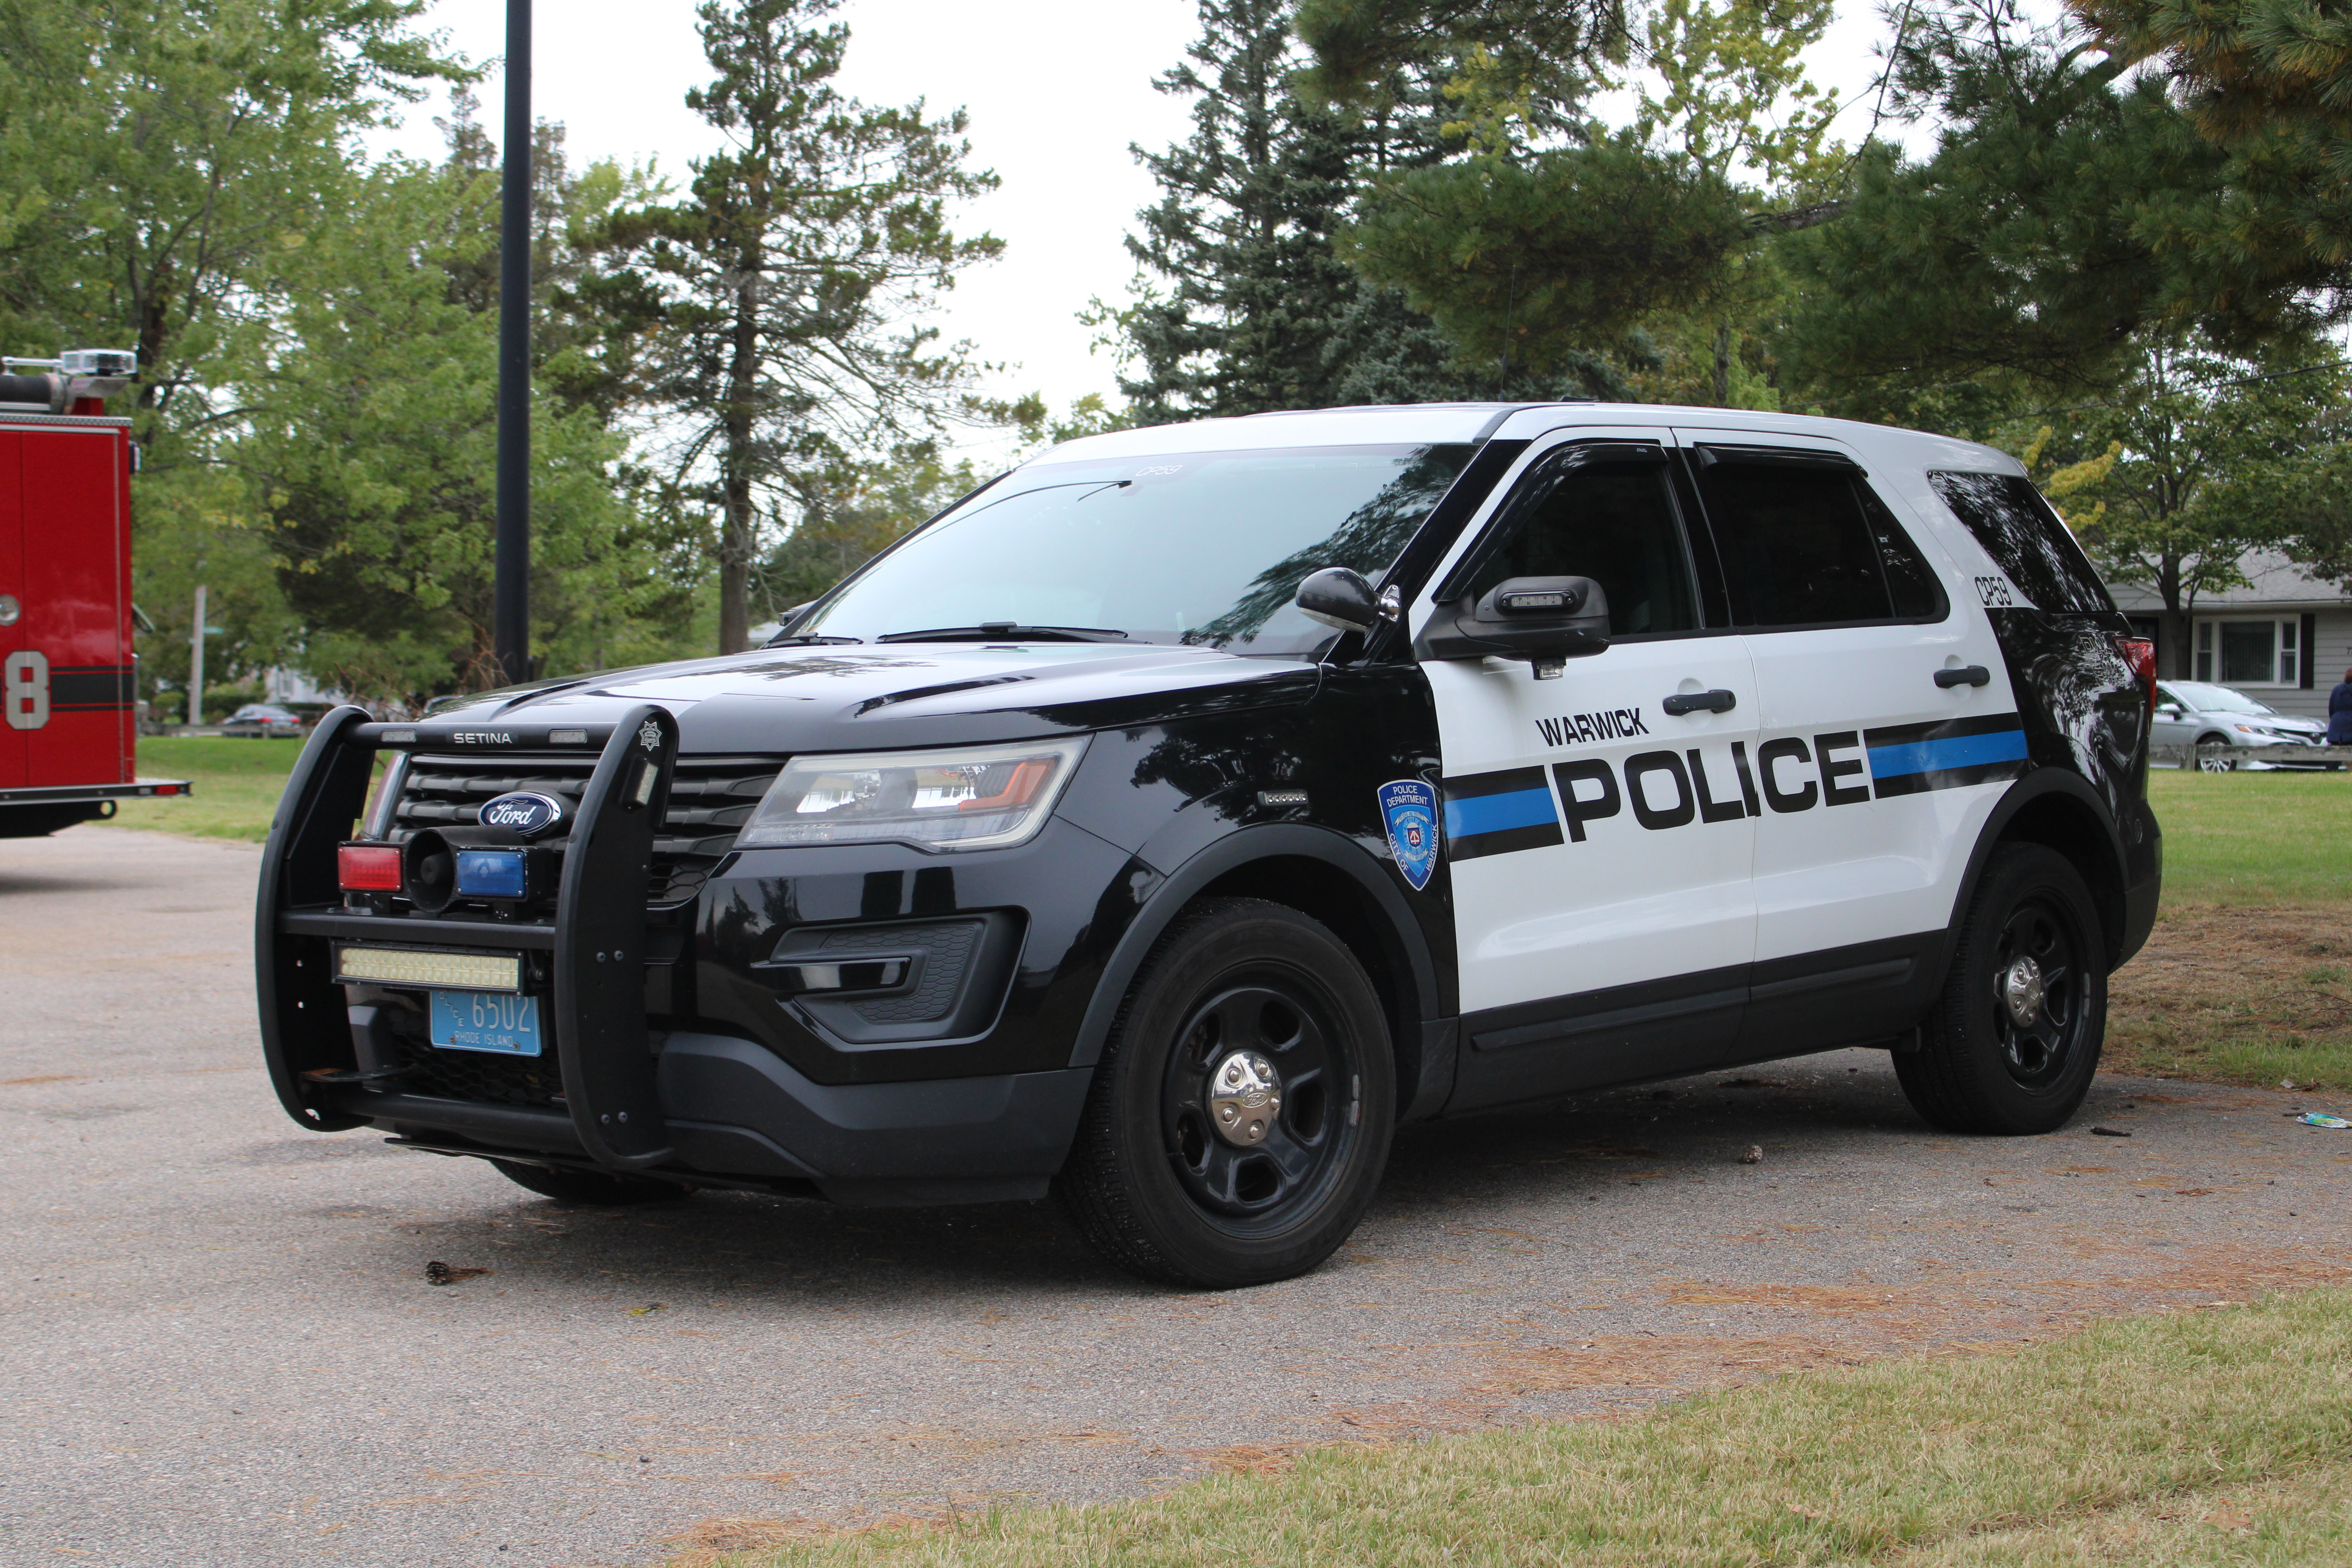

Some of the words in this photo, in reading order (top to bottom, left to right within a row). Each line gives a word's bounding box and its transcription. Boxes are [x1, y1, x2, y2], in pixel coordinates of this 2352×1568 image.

[1135, 465, 1183, 477] CP59
[1975, 577, 2012, 606] CP59
[4, 651, 49, 730] 8
[454, 733, 512, 744] SETINA
[1535, 708, 1649, 747] WARWICK
[1387, 794, 1428, 808] DEPARTMENT
[1393, 785, 1417, 795] POLICE
[1552, 730, 1870, 843] POLICE
[489, 798, 537, 825] Ford
[1390, 833, 1401, 856] CITY
[1400, 860, 1409, 871] OF
[1426, 824, 1437, 872] WARWICK
[439, 992, 464, 1027] OLICE
[473, 994, 530, 1032] 6502
[454, 1030, 481, 1044] RHODE
[484, 1033, 513, 1047] ISLAND
